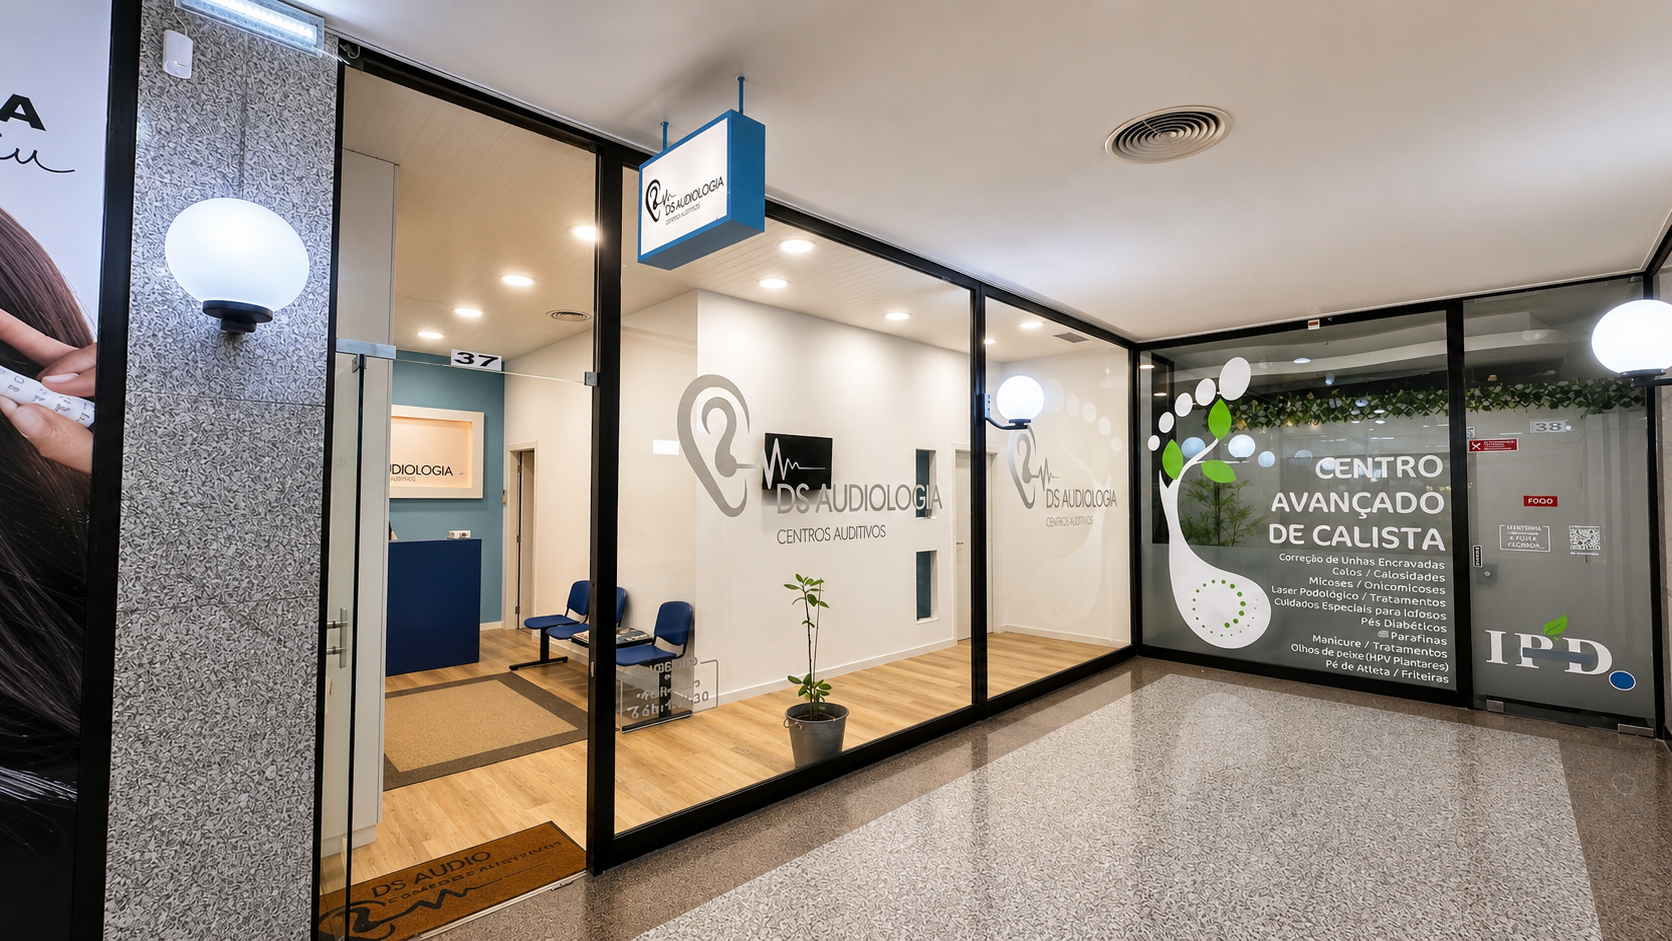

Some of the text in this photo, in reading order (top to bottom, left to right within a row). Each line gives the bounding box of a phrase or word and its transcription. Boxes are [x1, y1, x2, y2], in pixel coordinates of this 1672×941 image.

[665, 176, 724, 216] DS AUDIOLOGIA
[454, 351, 499, 367] 37
[1535, 422, 1562, 432] 38
[390, 464, 453, 476] DIOLOGIA
[1315, 454, 1443, 479] CENTRO
[776, 483, 943, 514] DS AUDIOLOGIA
[1046, 488, 1117, 508] DS AUDIOLOGIA
[1271, 491, 1445, 519] AVANÇADO
[776, 524, 886, 545] CENTROS AUDITIVOS
[1268, 523, 1446, 551] DE CALISTA
[1326, 554, 1339, 564] de
[1341, 556, 1376, 566] Unhas
[1378, 558, 1446, 570] Encravadas
[1332, 567, 1362, 577] Calos
[1373, 569, 1446, 583] Calosidades
[1309, 577, 1354, 588] Micoses
[1364, 581, 1446, 595] Onicomicoses
[1271, 586, 1298, 595] Laser
[1299, 587, 1359, 601] Podológico
[1370, 593, 1446, 608] Tratamentos
[1274, 597, 1320, 610] Cuidados
[1322, 601, 1372, 614] Especiais
[1375, 608, 1401, 618] para
[1361, 617, 1447, 633] Pés Diabéticos
[1312, 634, 1362, 648] Manicure
[1372, 641, 1448, 659] Tratamentos
[1391, 631, 1448, 646] Parafinas
[1291, 643, 1449, 672] Olhos de peixe (HPV Plantares)
[1325, 660, 1338, 669] Pé
[1341, 661, 1354, 671] de
[1356, 664, 1391, 677] Atleta
[370, 879, 407, 898] DS
[413, 850, 492, 885] AUDIO
